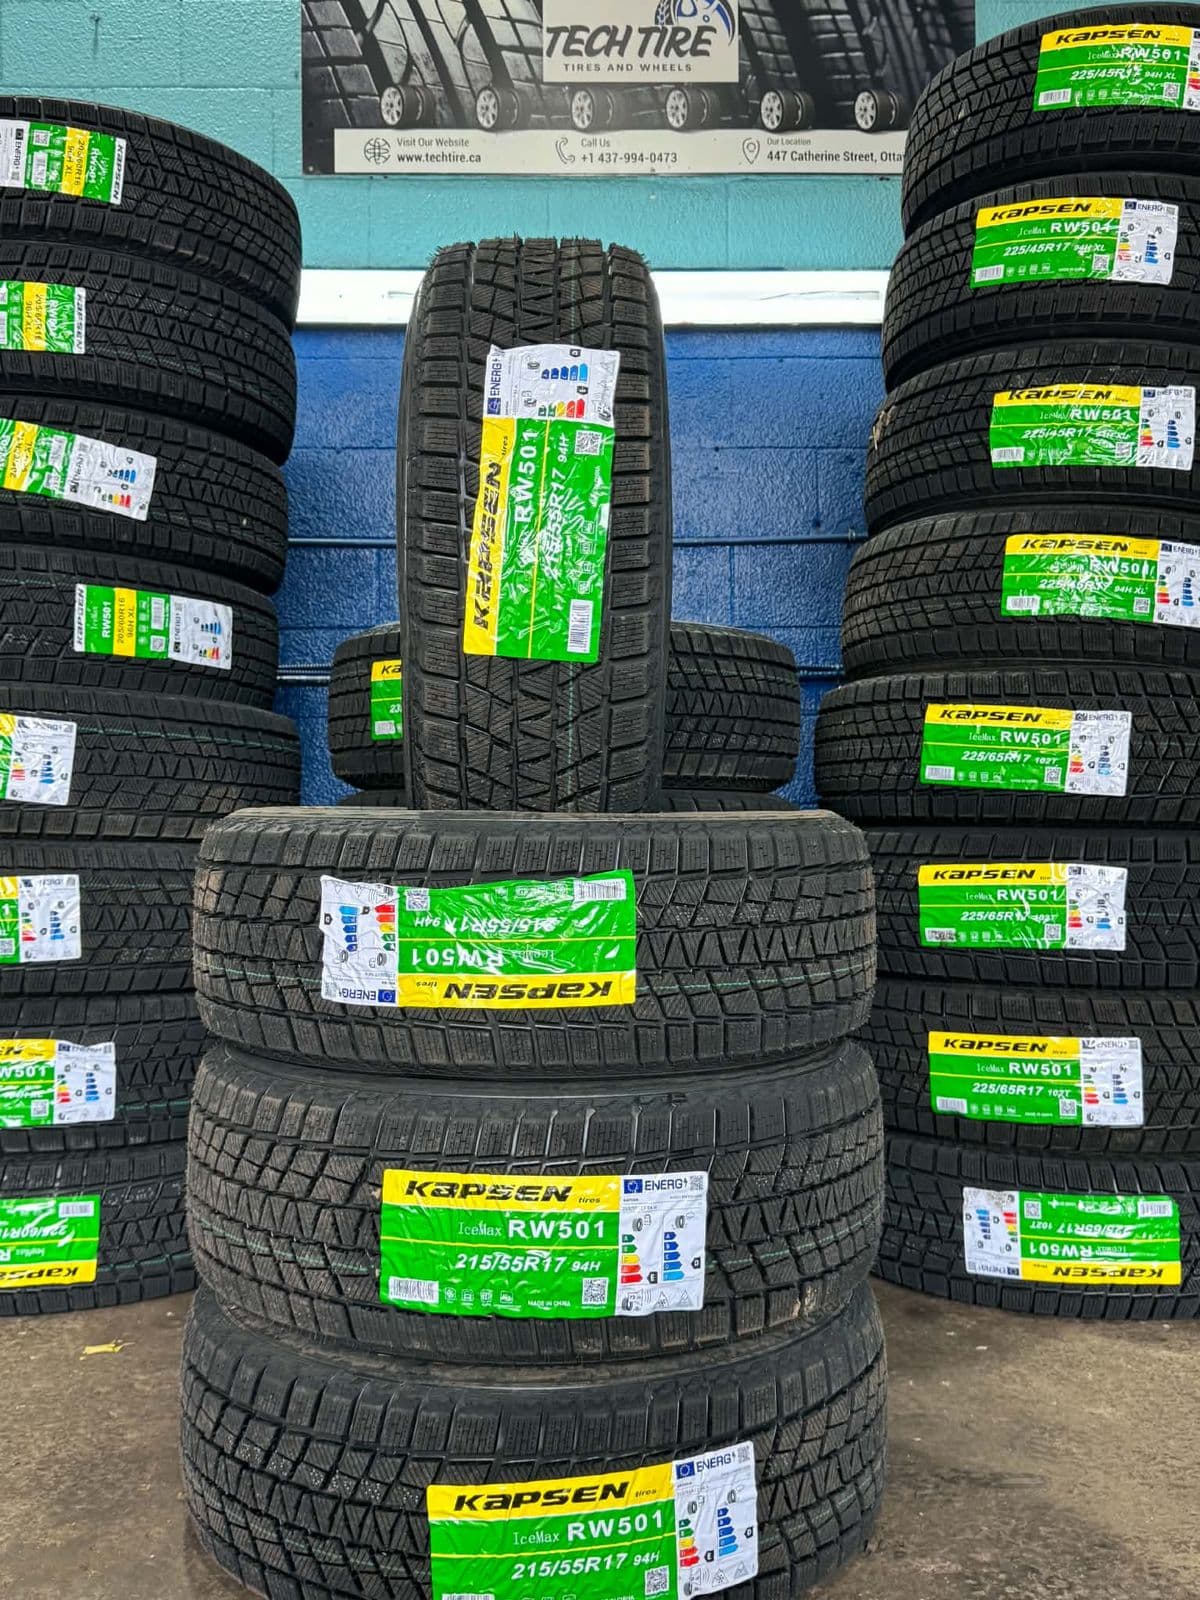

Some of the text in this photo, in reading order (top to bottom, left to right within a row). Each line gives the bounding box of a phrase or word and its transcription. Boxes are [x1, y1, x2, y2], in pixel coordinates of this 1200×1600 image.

[546, 25, 717, 58] TECH TIRE
[564, 63, 692, 72] TIRES AND WHEELS
[1164, 72, 1176, 80] XL
[397, 137, 469, 147] Visit Our Website
[581, 138, 610, 147] Call Us
[767, 137, 811, 146] Our Location
[397, 152, 481, 163] www.techtire.ca
[581, 152, 677, 163] +1 437-994-0473
[767, 150, 905, 163] 447 Catherine Street, Otta
[1003, 242, 1070, 257] 225/45R17
[489, 363, 503, 397] ENERG
[557, 433, 570, 463] 94H
[513, 430, 539, 524] RW501
[102, 601, 112, 638] RW501
[1000, 731, 1061, 745] RW501
[961, 751, 1031, 763] 225/65R17
[997, 889, 1058, 901] RW501
[414, 916, 441, 927] 94H
[411, 948, 504, 967] RW501
[341, 988, 377, 1001] ENERG
[0, 1066, 46, 1078] W501
[1009, 1062, 1072, 1076] RW501
[972, 1082, 1043, 1096] 225/65R17
[644, 1179, 682, 1191] ENERG
[458, 1220, 605, 1239] IceMax RW501
[1029, 1242, 1092, 1257] RW501
[455, 1252, 601, 1273] 215/55R17 94H
[696, 1453, 732, 1473] ENERG
[512, 1509, 664, 1545] IceMax RW501
[511, 1552, 660, 1580] 215/55R17 94H
